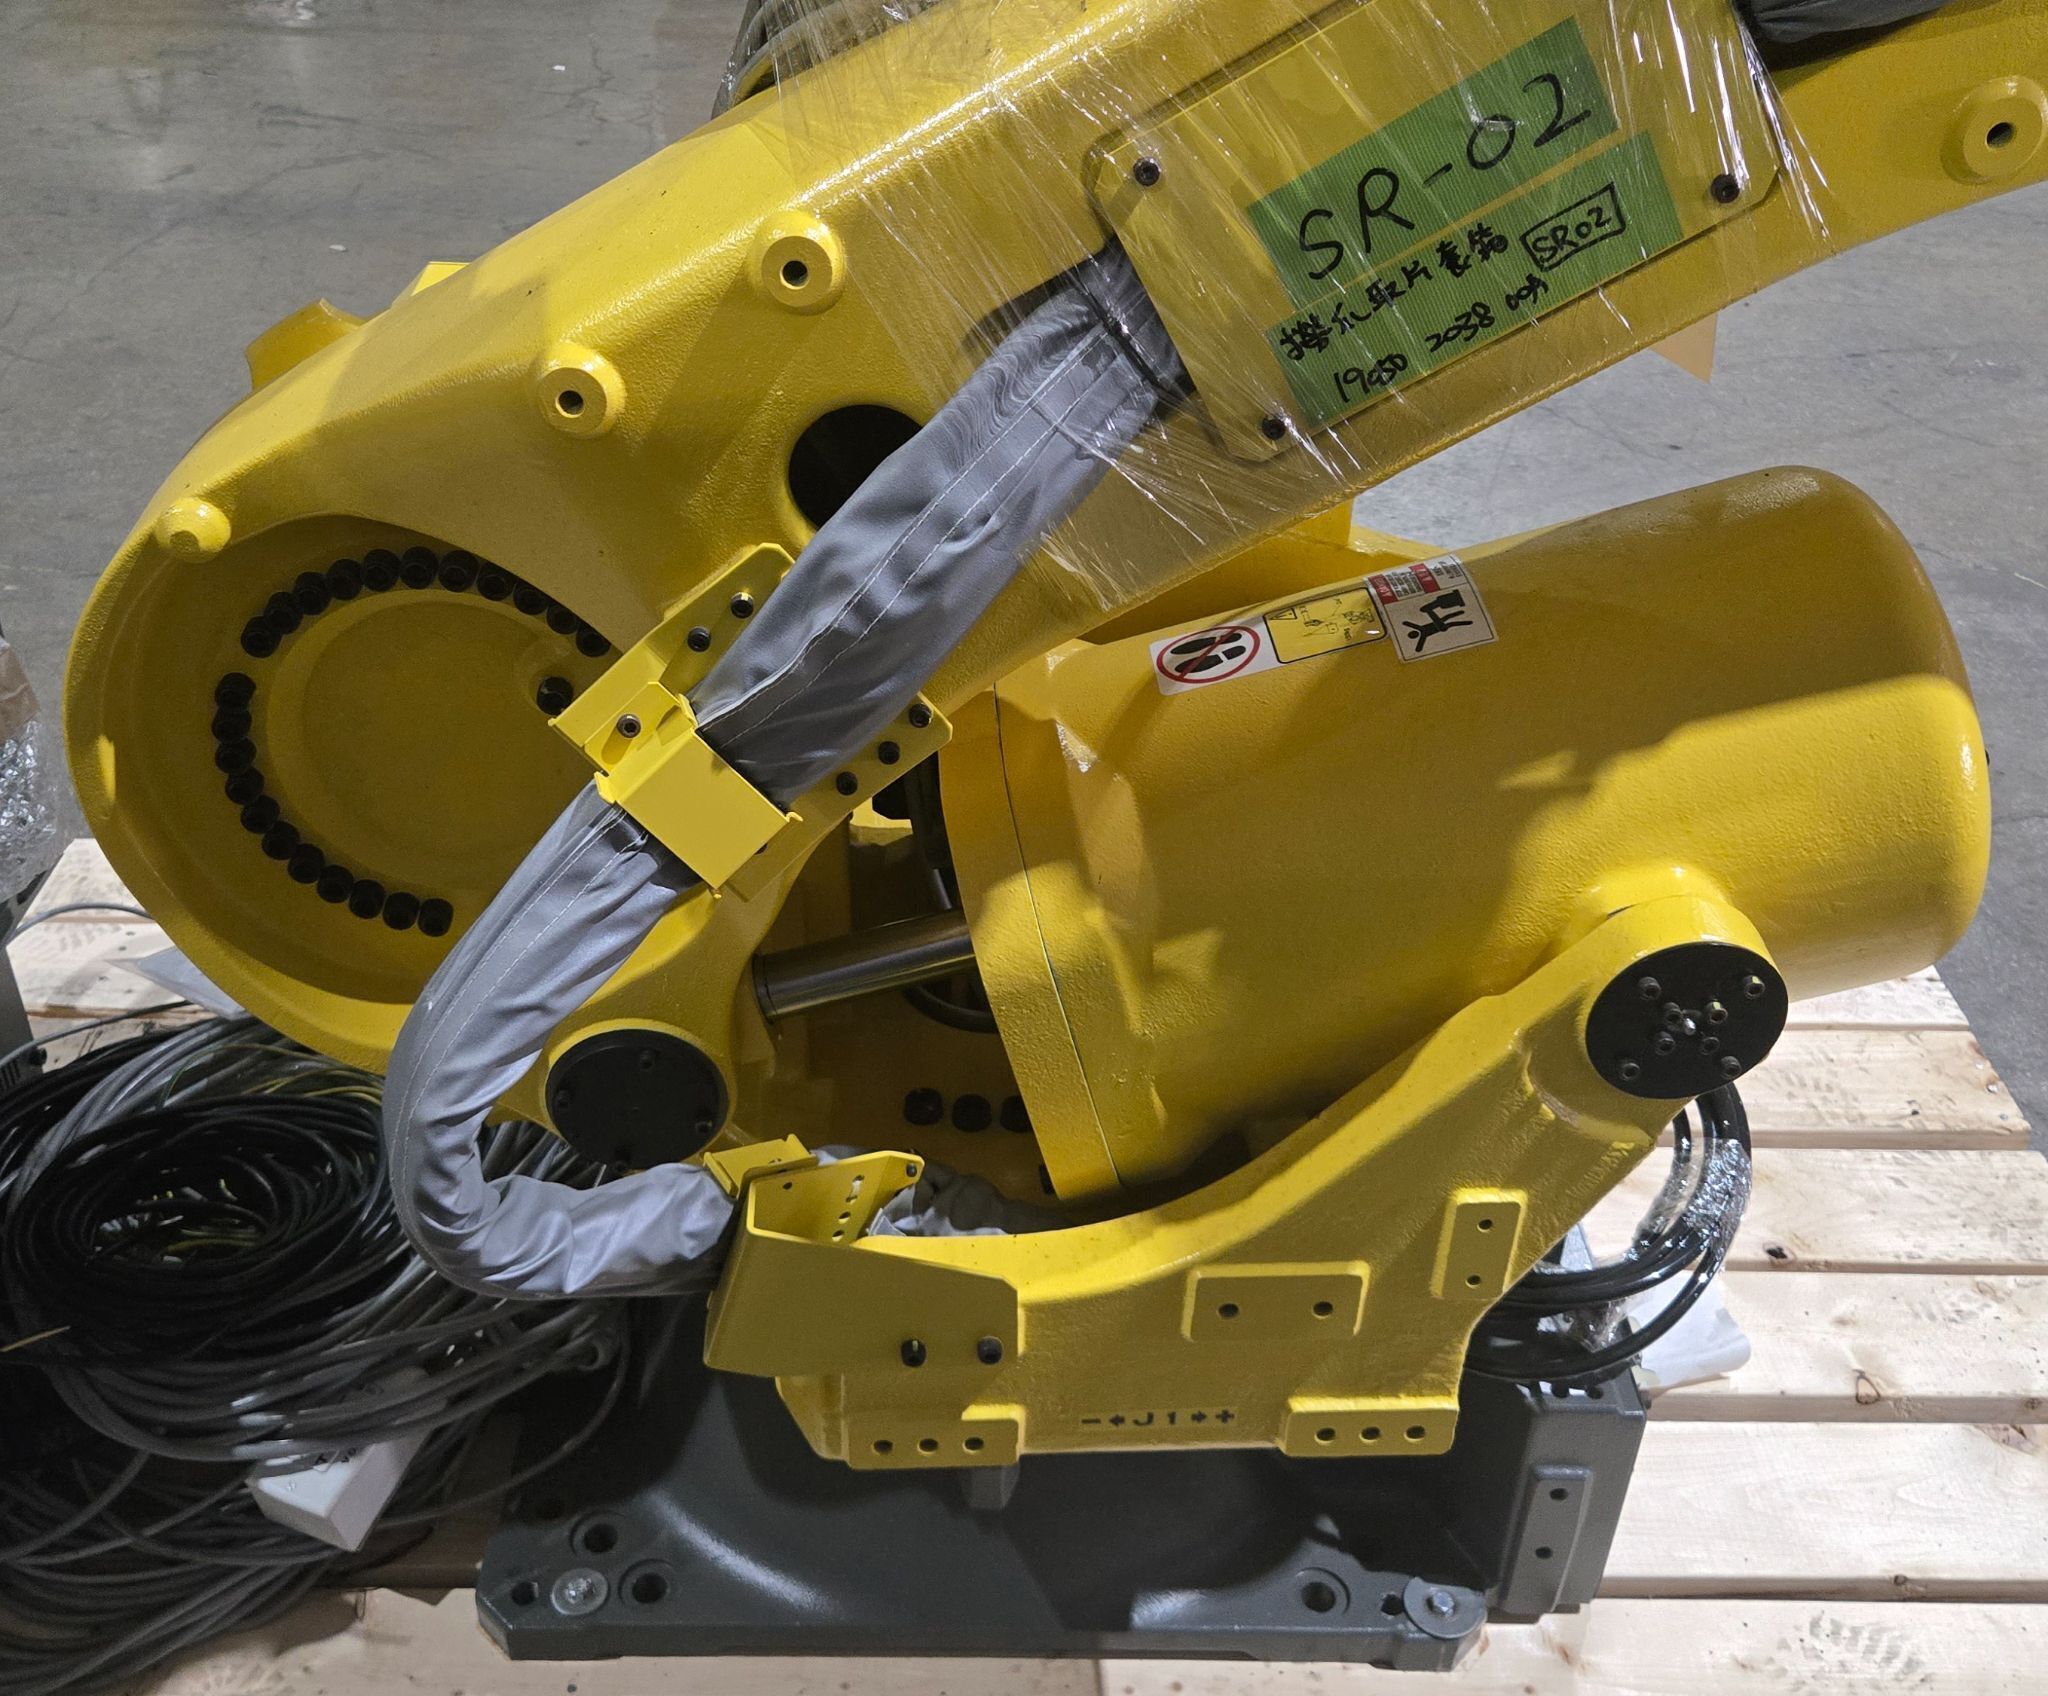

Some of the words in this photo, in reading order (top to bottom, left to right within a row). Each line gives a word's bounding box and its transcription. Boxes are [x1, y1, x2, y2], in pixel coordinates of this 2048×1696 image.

[1299, 73, 1592, 280] SR-02
[1531, 206, 1612, 264] SR02
[1425, 302, 1495, 353] 2038
